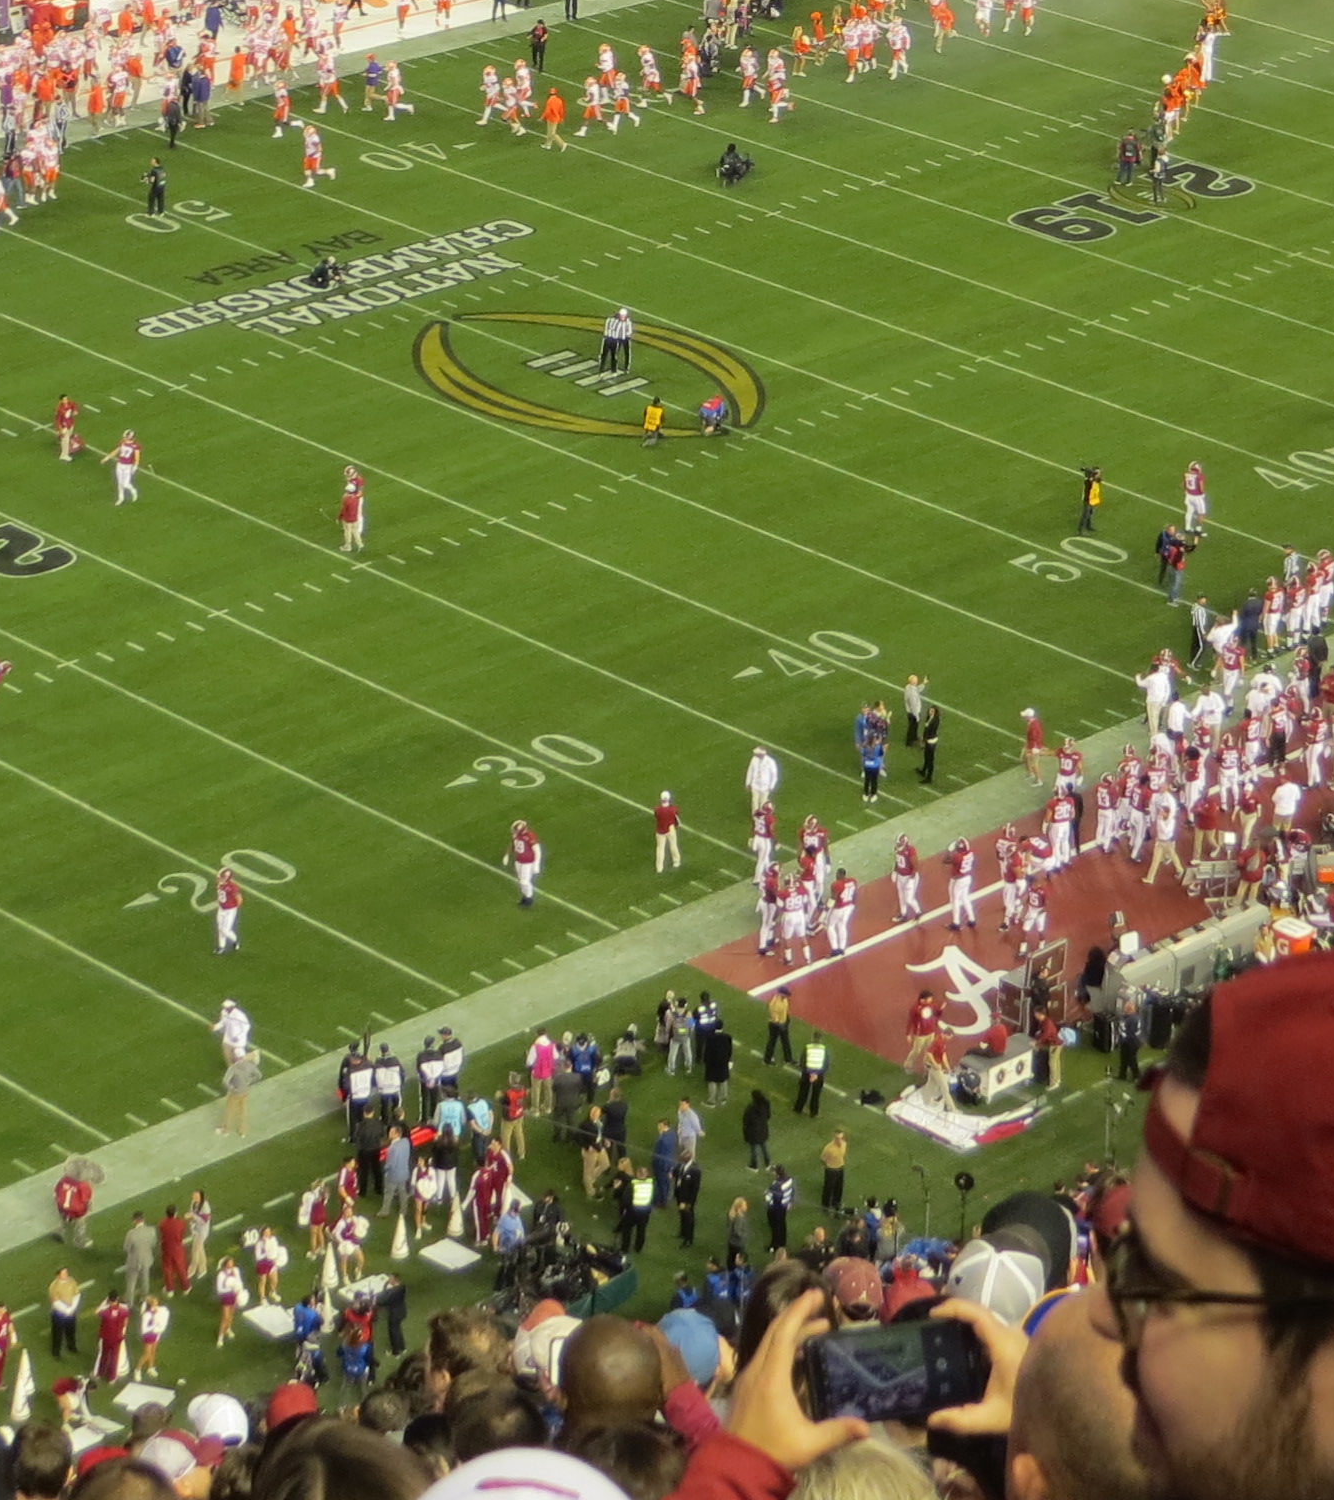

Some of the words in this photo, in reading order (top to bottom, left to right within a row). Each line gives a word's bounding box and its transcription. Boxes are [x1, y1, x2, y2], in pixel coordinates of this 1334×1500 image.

[359, 140, 449, 172] 40
[125, 200, 232, 233] 50
[185, 249, 298, 287] AREA
[300, 229, 385, 258] BAY
[137, 218, 537, 339] CHAMPONSHIP
[236, 251, 523, 336] NATIONAL
[1007, 533, 1129, 583] 50
[763, 629, 881, 679] 40
[474, 732, 605, 790] 30
[156, 847, 298, 914] 20
